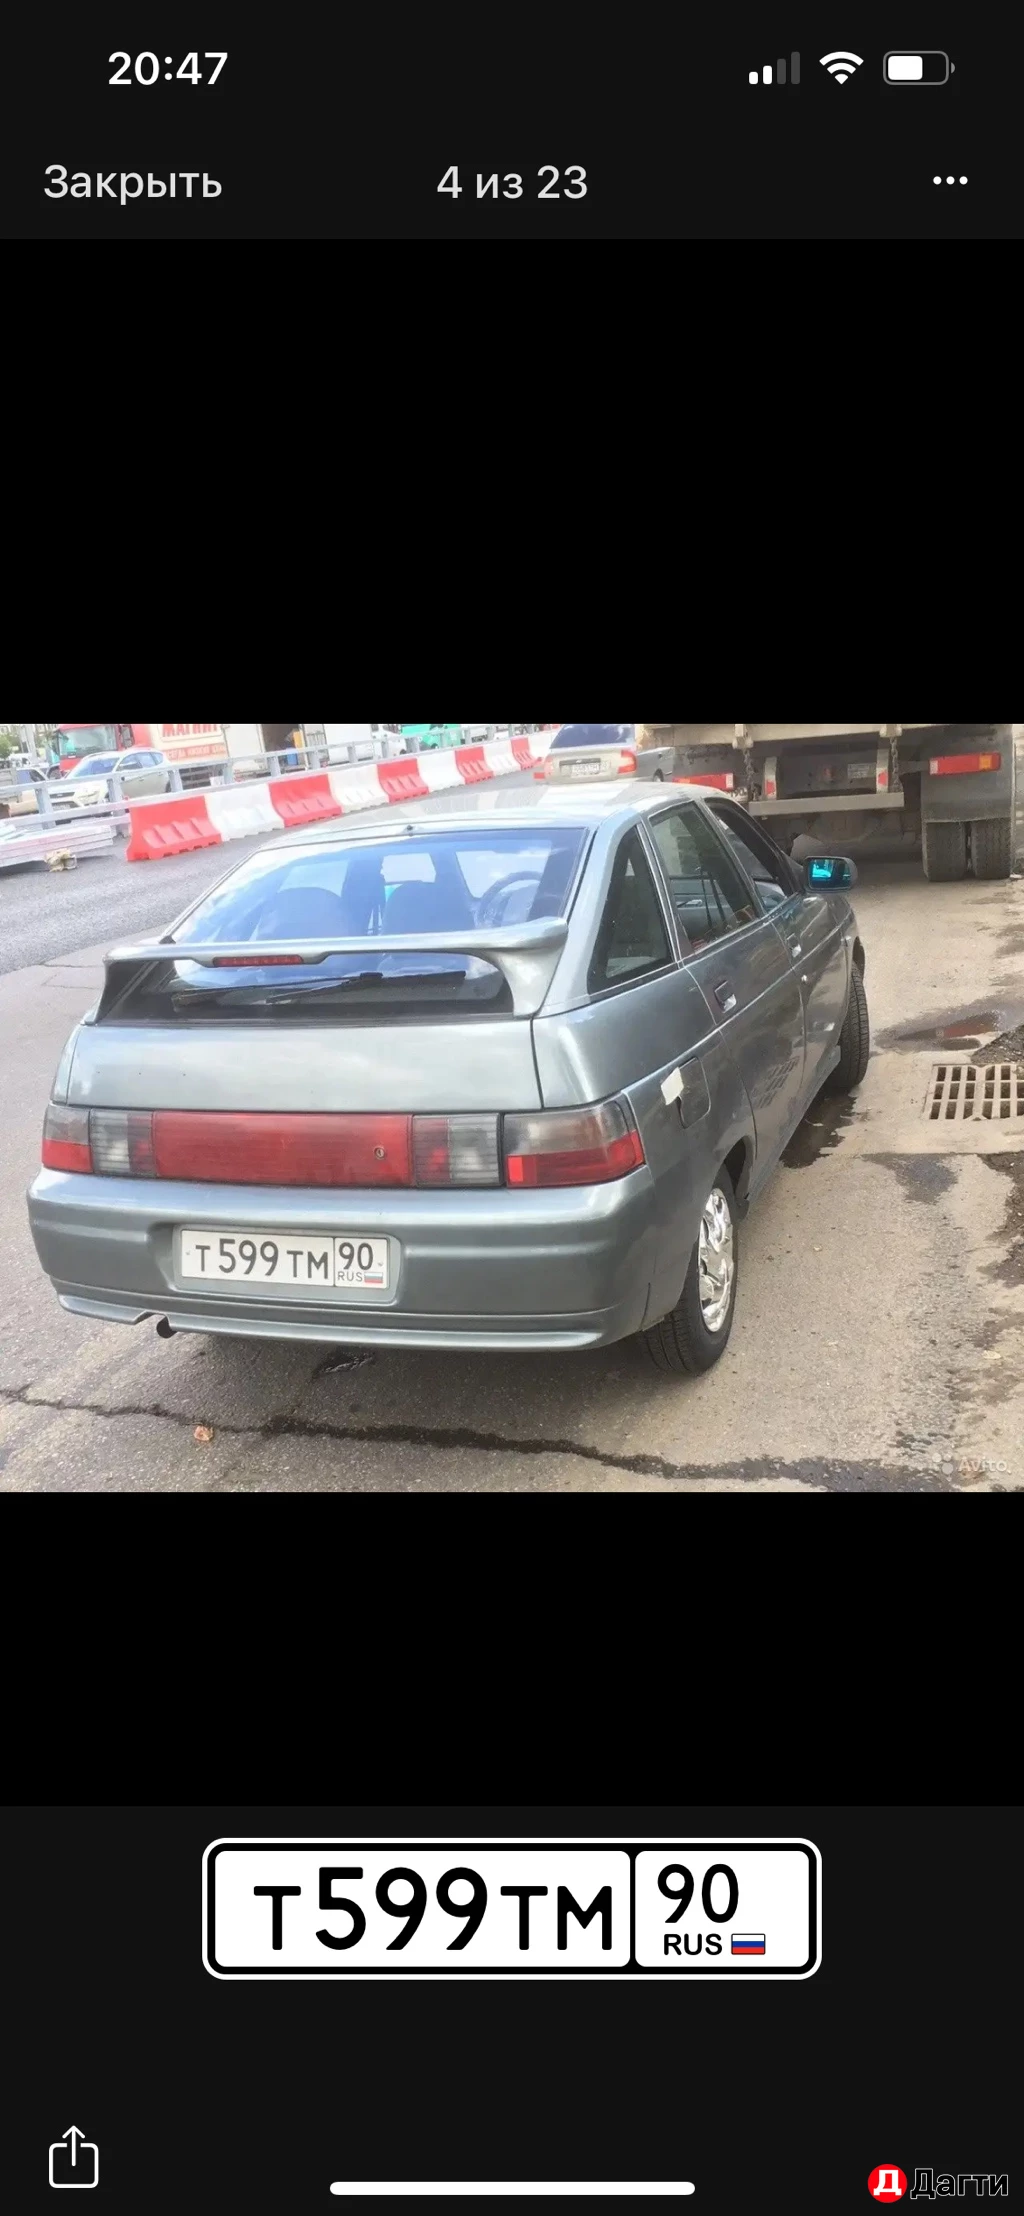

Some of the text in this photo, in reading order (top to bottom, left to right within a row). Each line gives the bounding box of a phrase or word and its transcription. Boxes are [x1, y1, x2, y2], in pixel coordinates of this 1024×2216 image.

[109, 52, 227, 85] 20:47
[43, 165, 222, 205] Закрыть
[437, 165, 587, 199] 4 из 23
[338, 1242, 373, 1270] 90
[337, 1271, 363, 1282] RUS
[658, 1864, 738, 1923] 90
[664, 1934, 722, 1955] RUS
